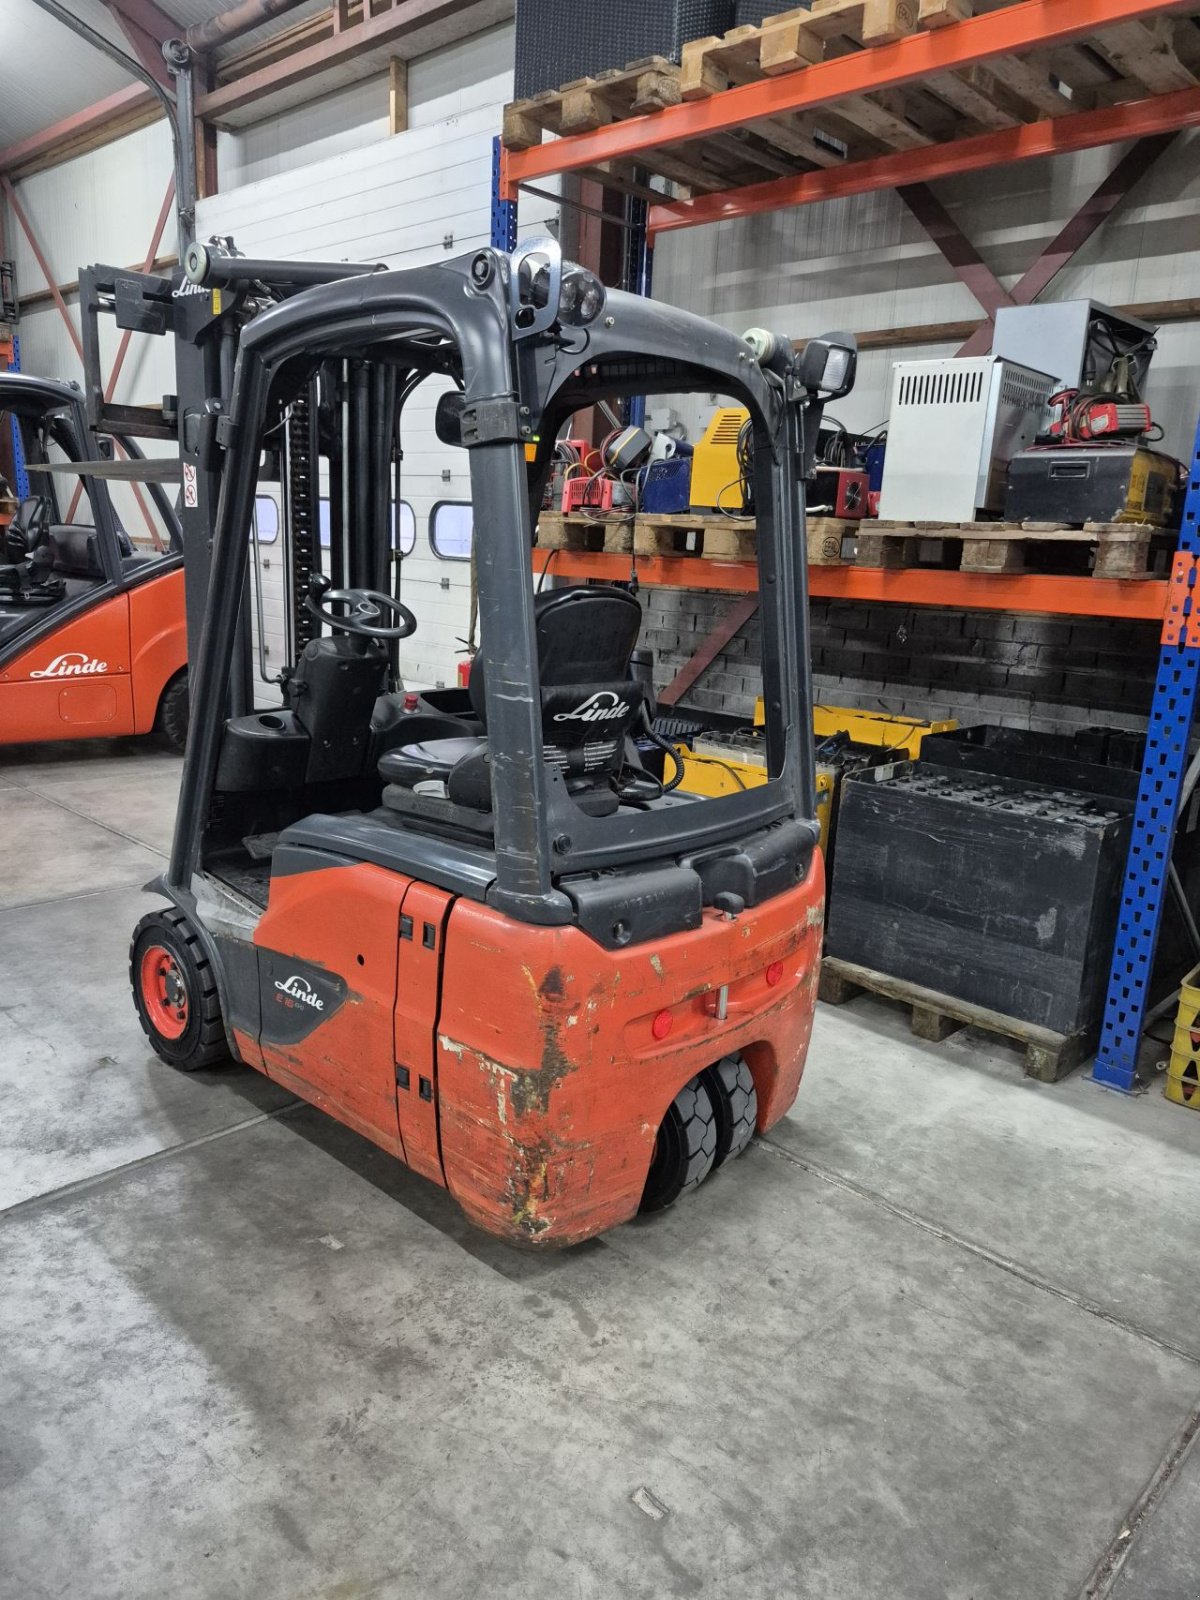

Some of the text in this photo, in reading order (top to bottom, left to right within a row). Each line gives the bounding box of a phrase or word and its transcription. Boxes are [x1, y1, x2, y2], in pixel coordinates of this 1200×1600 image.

[171, 275, 212, 298] Lin
[29, 652, 108, 679] Linde
[552, 691, 630, 721] Linde
[274, 975, 324, 1011] Linde
